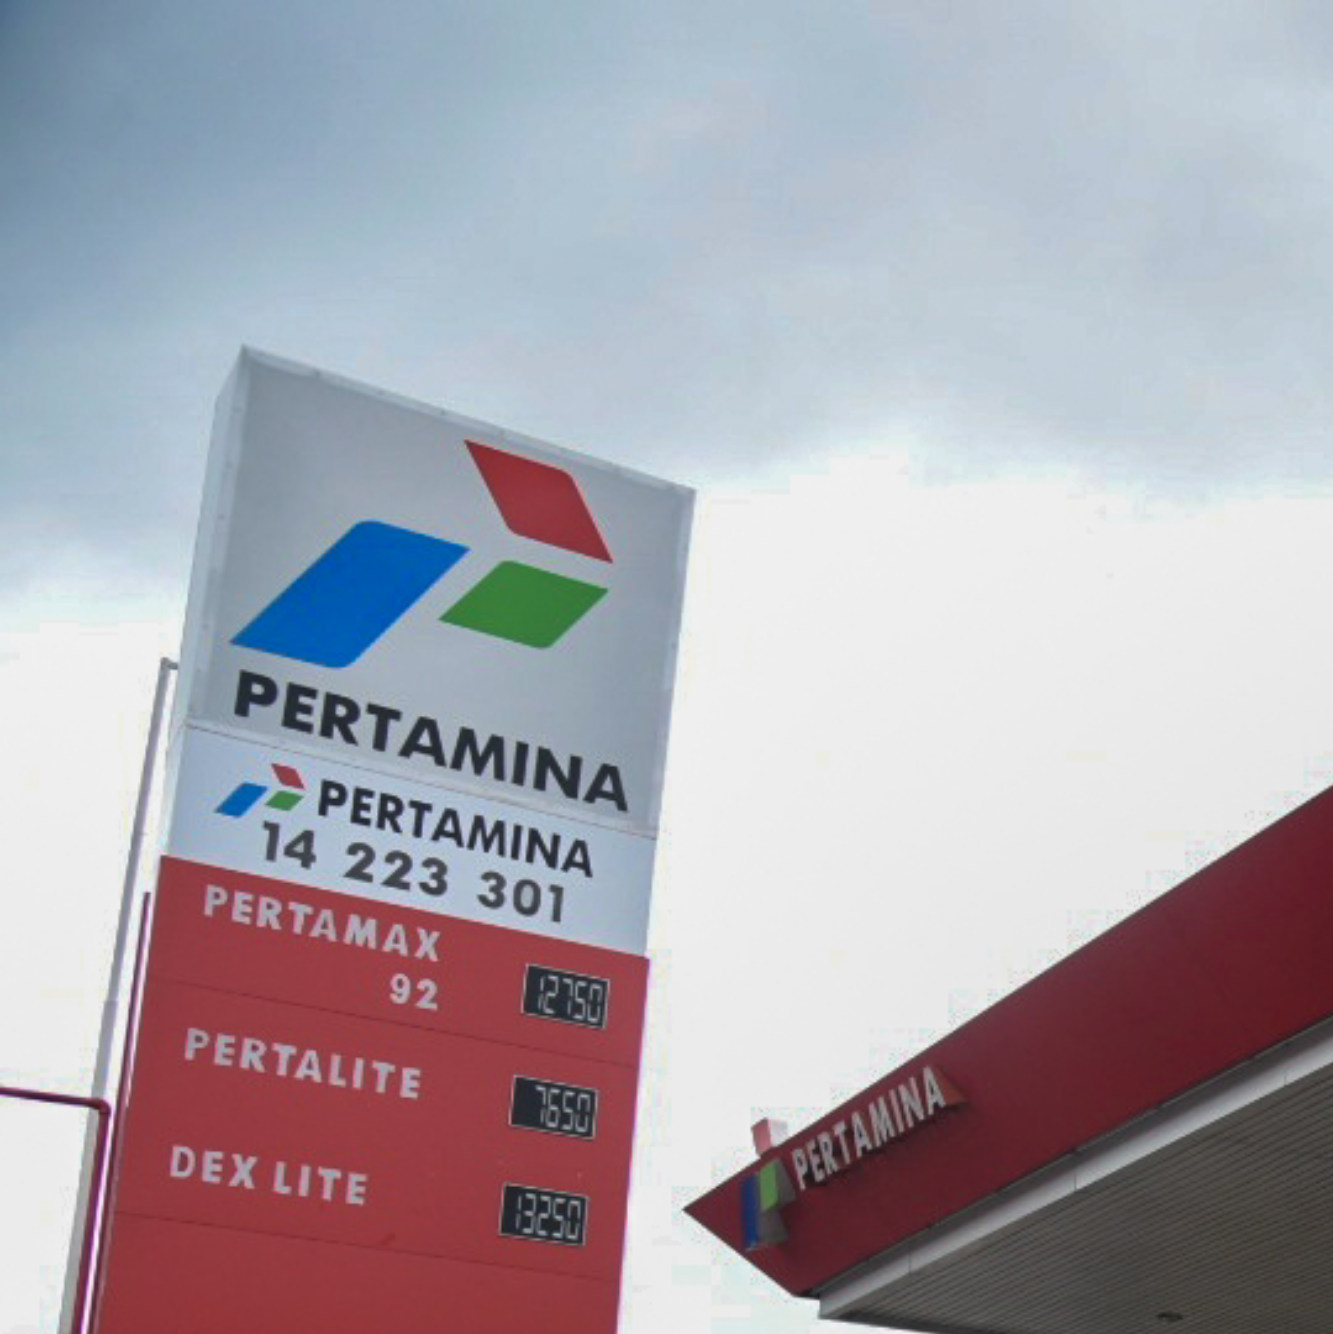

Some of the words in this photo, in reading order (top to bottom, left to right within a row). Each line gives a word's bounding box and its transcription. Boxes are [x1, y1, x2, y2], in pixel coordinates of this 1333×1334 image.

[234, 669, 629, 811] PERTAMINA
[317, 779, 593, 877] PERTAMINA
[261, 821, 317, 869] 14
[344, 842, 449, 896] 223
[477, 871, 565, 923] 301
[203, 884, 442, 962] PERTAMAX
[389, 973, 439, 1010] 92
[537, 974, 603, 1024] 12750
[184, 1027, 422, 1099] PERTALITE
[535, 1085, 591, 1133] 7650
[792, 1066, 947, 1190] PERTAMINA
[169, 1145, 258, 1190] DEX
[273, 1160, 368, 1206] LITE
[515, 1193, 581, 1240] 13250
